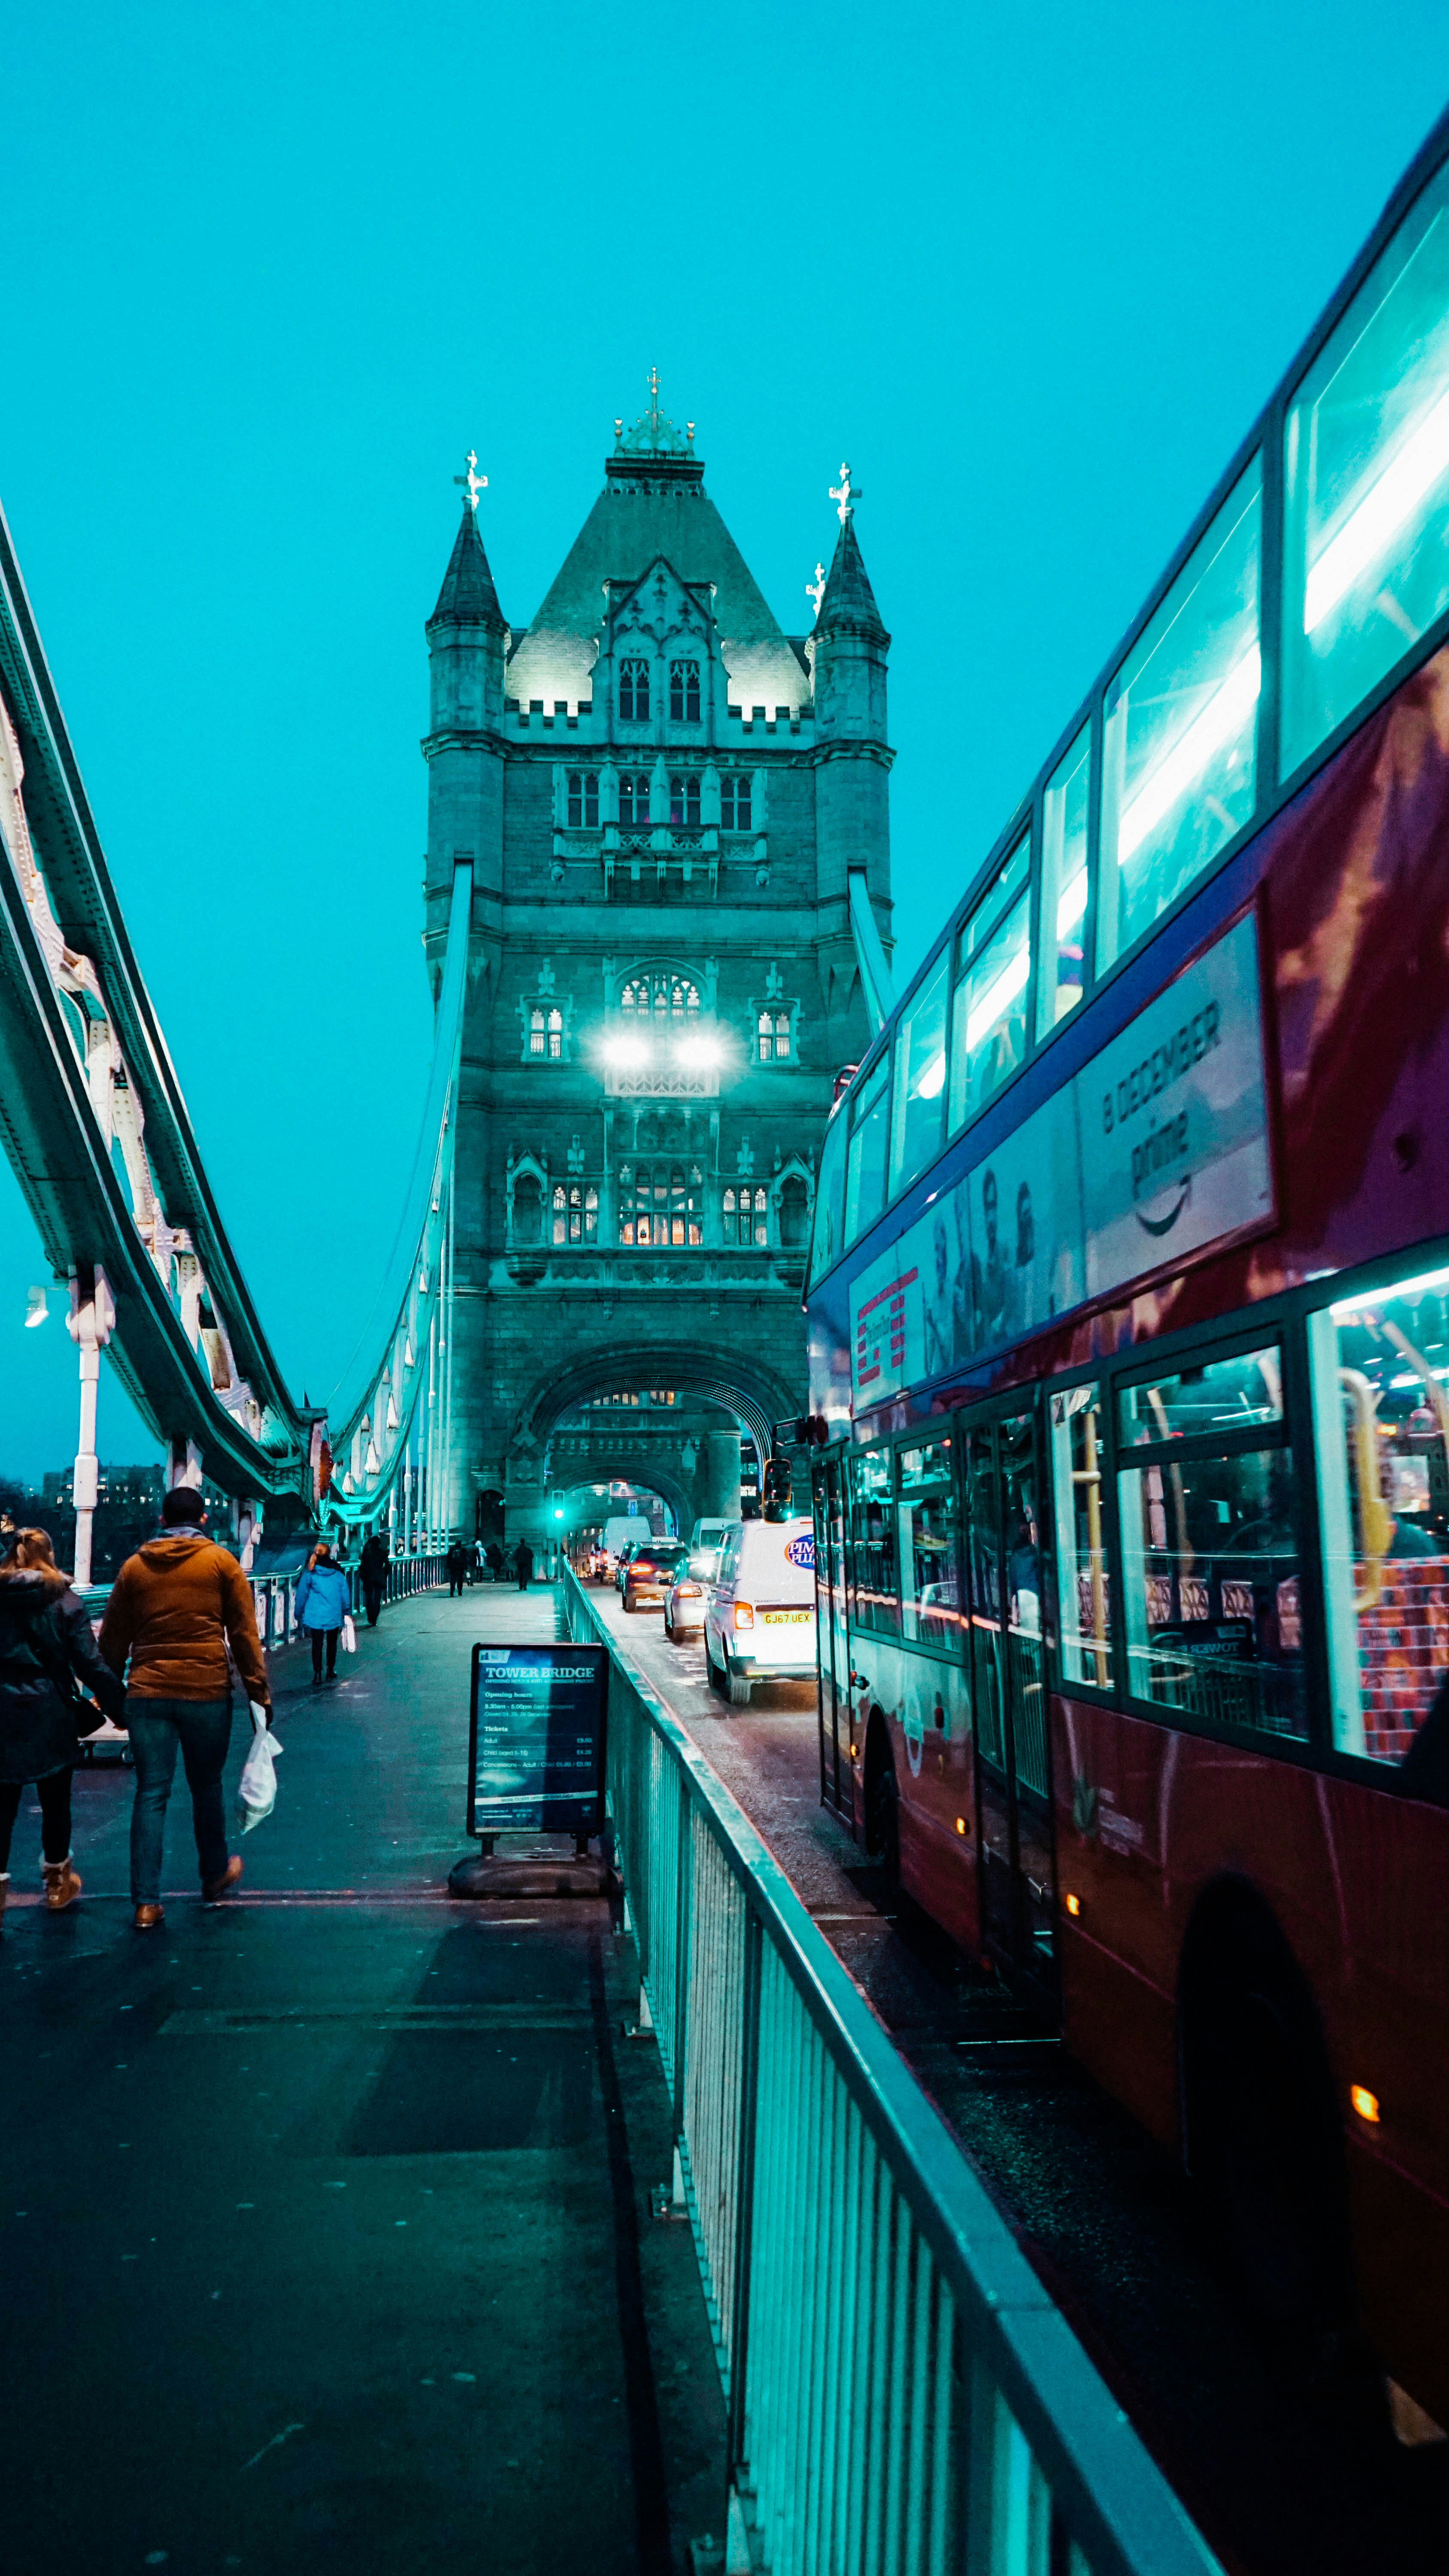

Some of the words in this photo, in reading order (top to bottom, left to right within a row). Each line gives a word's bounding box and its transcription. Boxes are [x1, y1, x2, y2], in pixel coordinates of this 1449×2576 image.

[1103, 1093, 1114, 1135] 8
[1118, 999, 1221, 1124] DECEMBER
[1132, 1109, 1188, 1201] prime
[791, 1553, 815, 1563] PLU
[766, 1614, 789, 1623] GJ67
[792, 1614, 809, 1622] UEX
[486, 1667, 538, 1678] TOWER
[540, 1667, 594, 1678] BRIDGE
